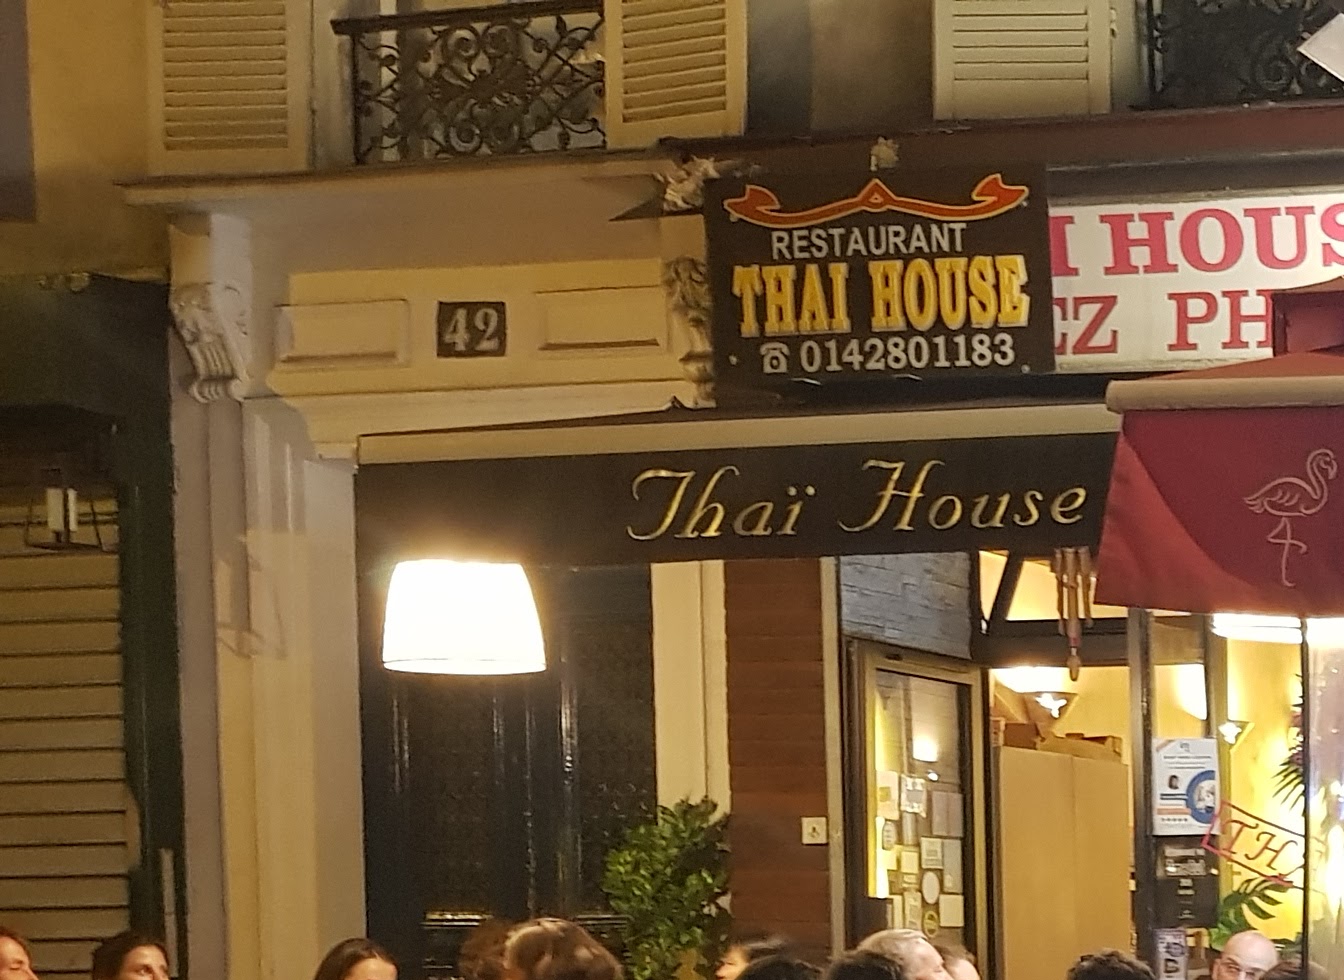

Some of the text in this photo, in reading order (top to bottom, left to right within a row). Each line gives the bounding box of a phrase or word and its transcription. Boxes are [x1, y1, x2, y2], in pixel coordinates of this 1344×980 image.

[771, 223, 967, 260] RESTAURANT
[732, 255, 1032, 338] THAI HOUSE
[443, 307, 500, 351] 42
[800, 333, 1016, 373] 0142801183
[627, 459, 1087, 541] Thaï House
